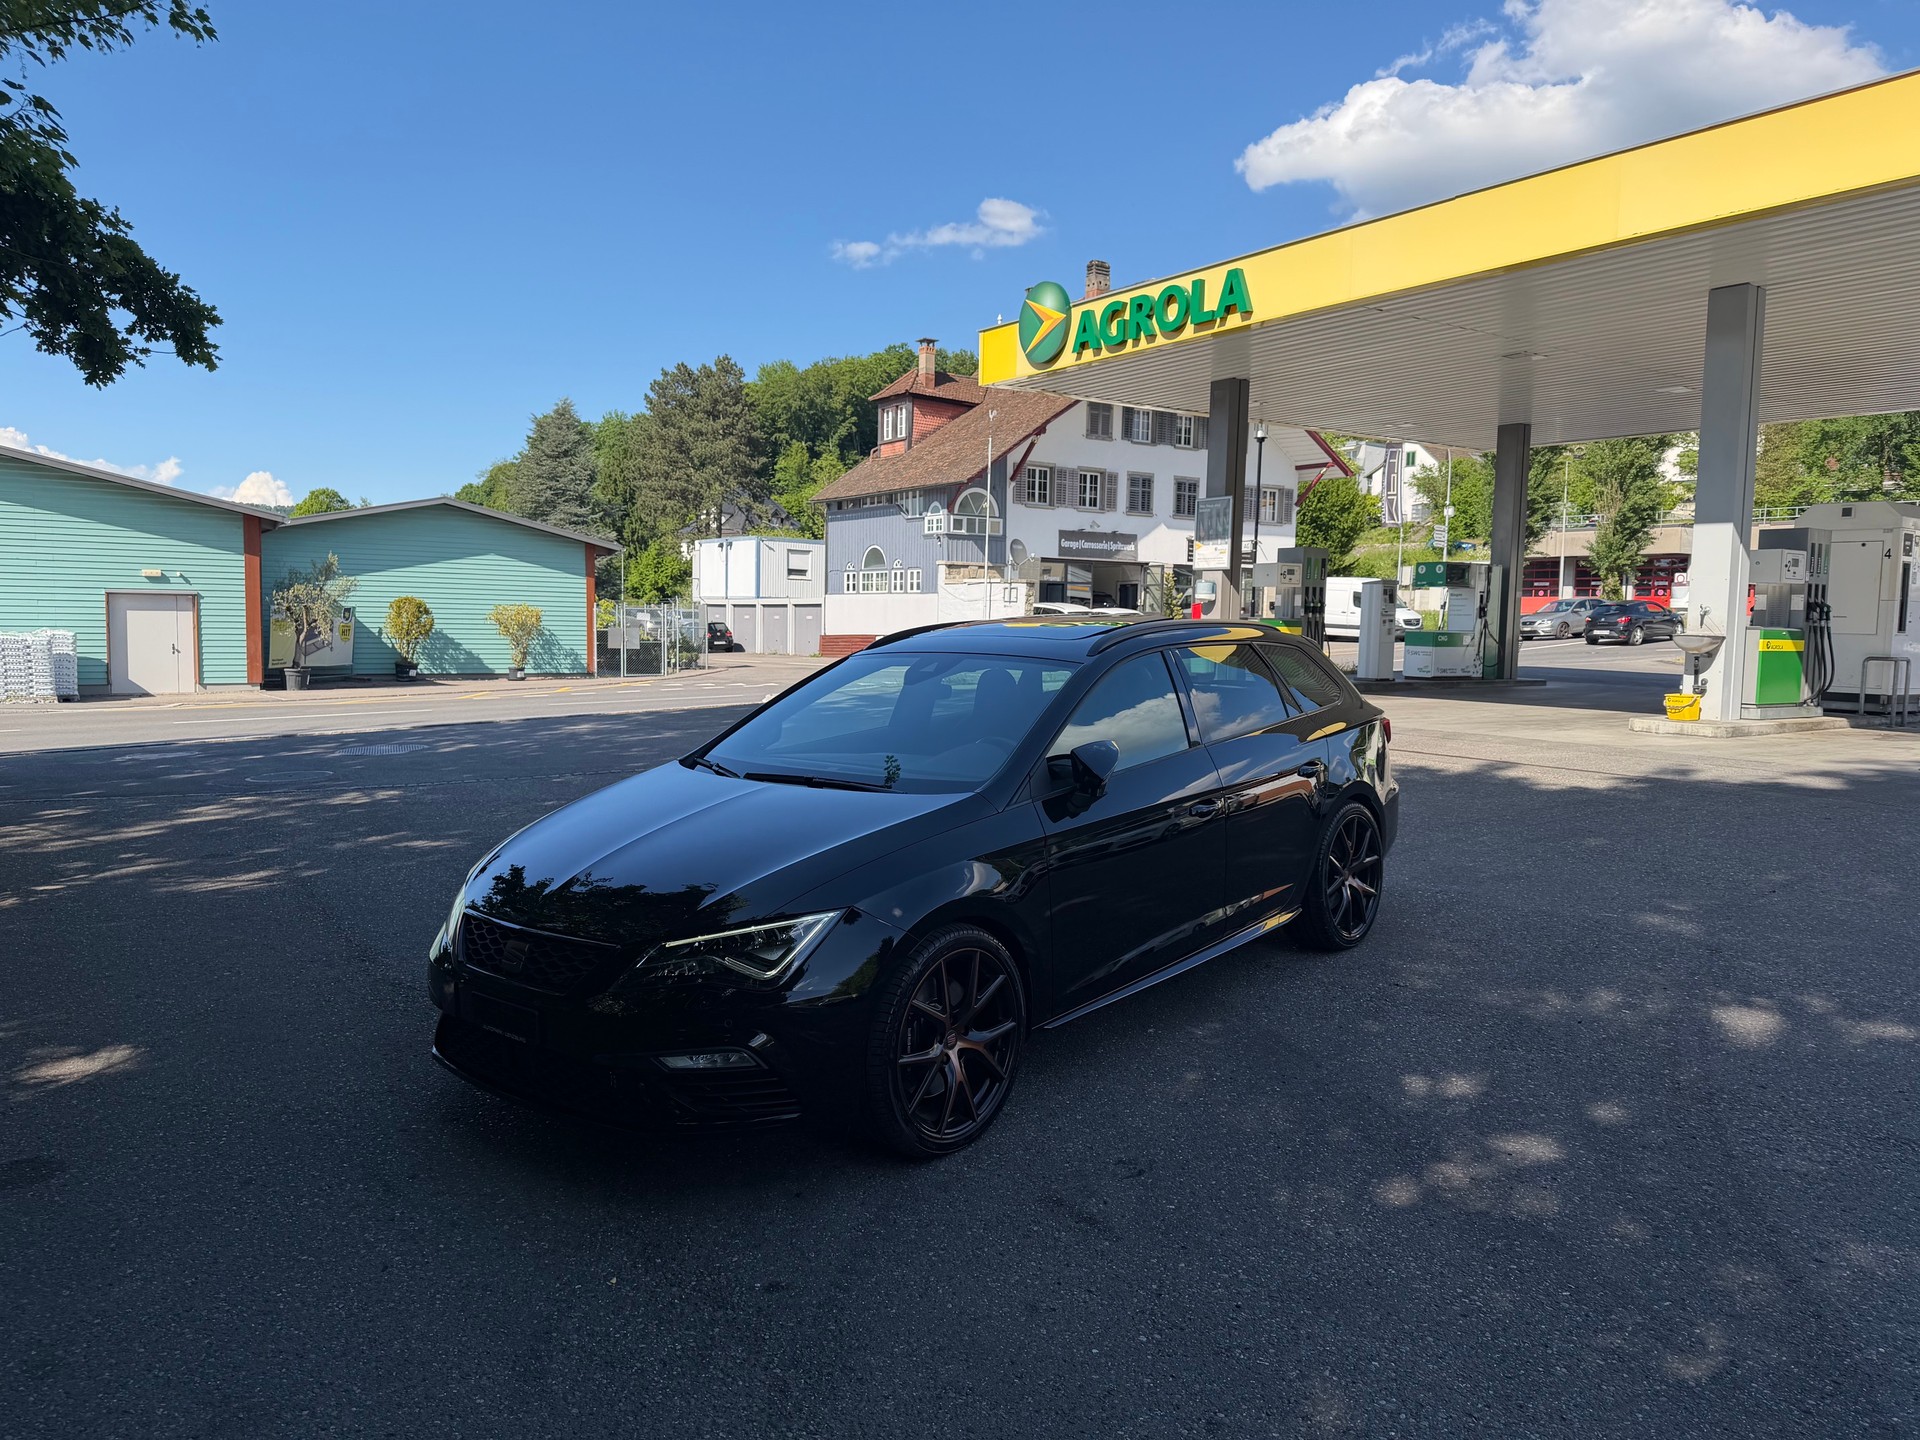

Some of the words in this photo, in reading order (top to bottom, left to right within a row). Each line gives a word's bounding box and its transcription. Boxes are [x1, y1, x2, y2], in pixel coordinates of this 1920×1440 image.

[1072, 268, 1253, 354] AGROLA
[1060, 539, 1079, 550] Garage
[1884, 548, 1892, 560] 4
[341, 628, 351, 637] HIT
